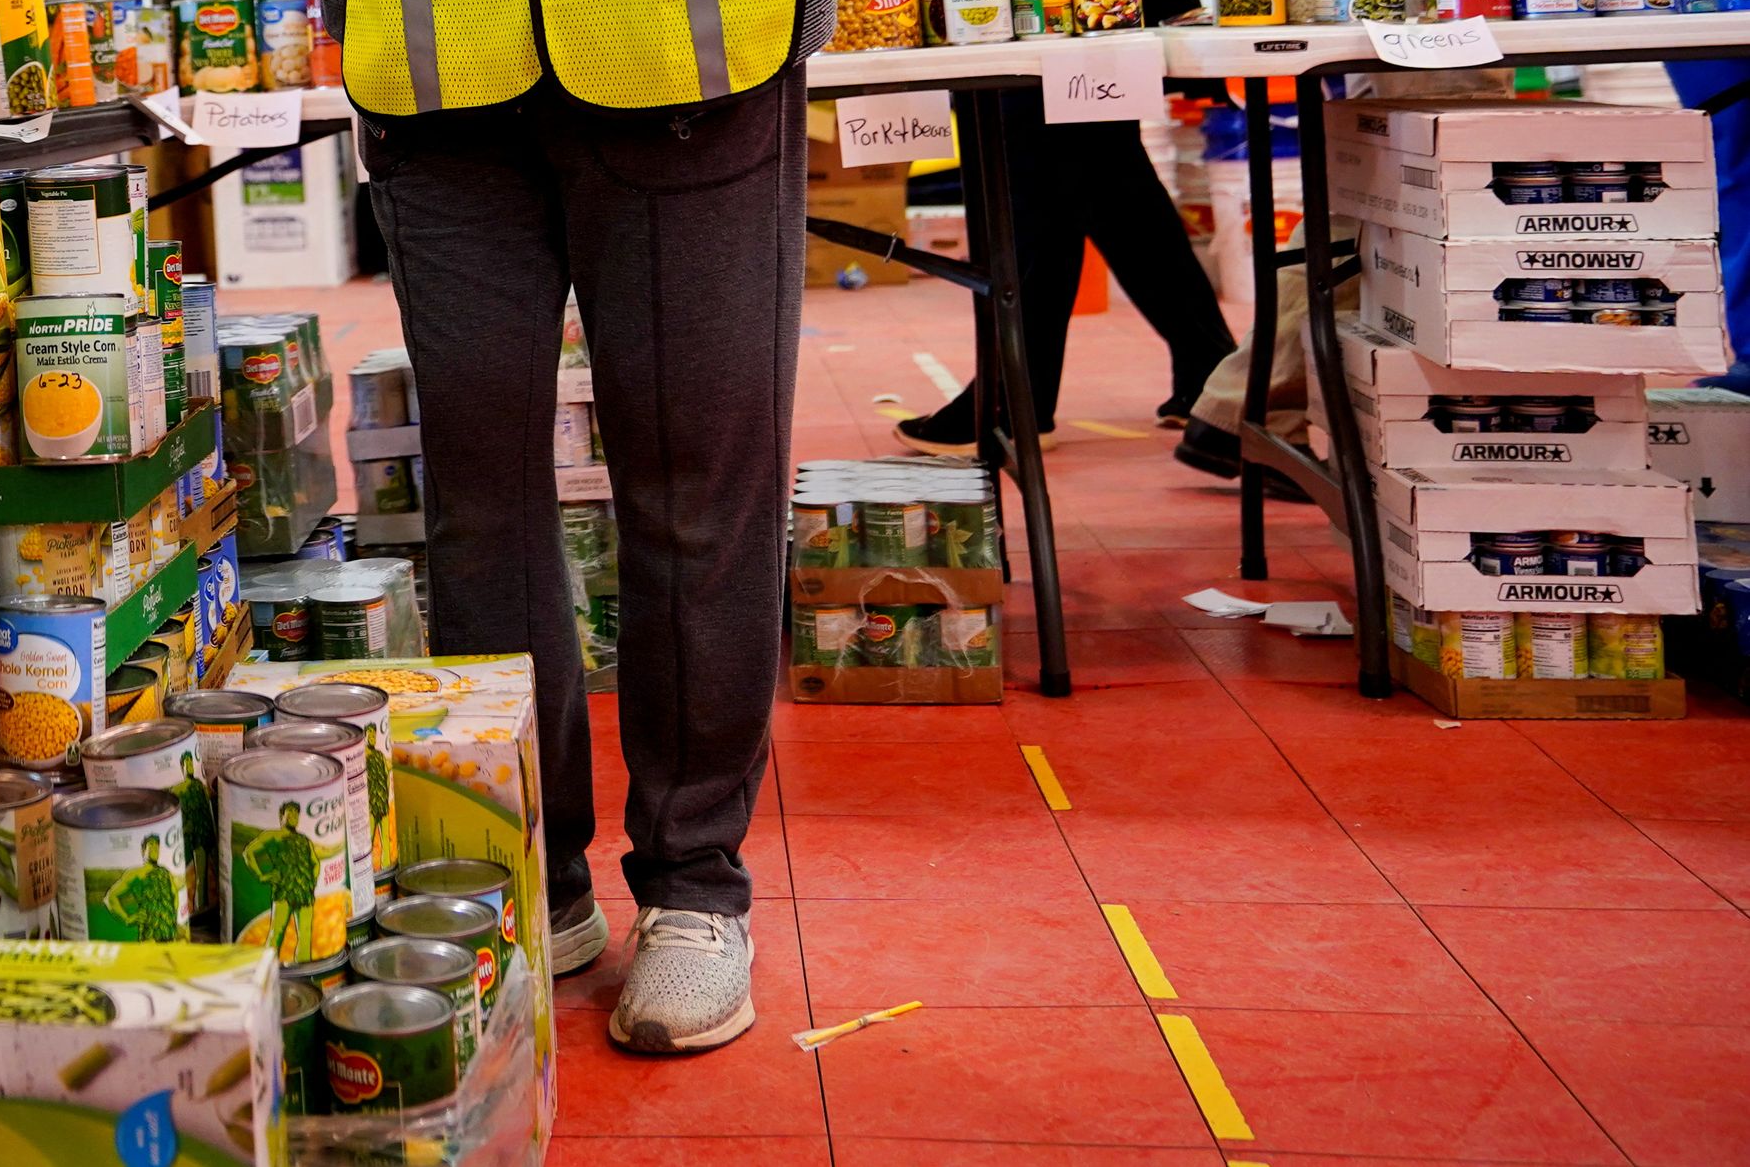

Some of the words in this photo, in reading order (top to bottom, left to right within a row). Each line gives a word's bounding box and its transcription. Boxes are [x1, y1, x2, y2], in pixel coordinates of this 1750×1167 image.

[1383, 29, 1482, 60] greens
[1069, 74, 1126, 100] Misc.
[1523, 217, 1613, 233] ARMOUR
[1543, 252, 1636, 269] ARMOUR
[29, 321, 62, 335] NORTH
[63, 317, 114, 333] PRIDE
[26, 343, 58, 355] Cream
[62, 341, 91, 355] Style
[93, 341, 116, 353] Corn
[57, 355, 80, 366] Estilo
[82, 354, 108, 365] Crema
[38, 372, 83, 390] 6-23
[1459, 445, 1548, 461] ARMOUR
[130, 538, 147, 553] ORN
[1514, 556, 1543, 567] ARMO
[1505, 585, 1599, 601] ARMOUR
[20, 652, 44, 662] Golden
[46, 652, 68, 662] Sweet
[25, 663, 68, 676] Kernel
[37, 679, 68, 690] Corn
[306, 795, 345, 819] Gree
[337, 1062, 376, 1085] Monte
